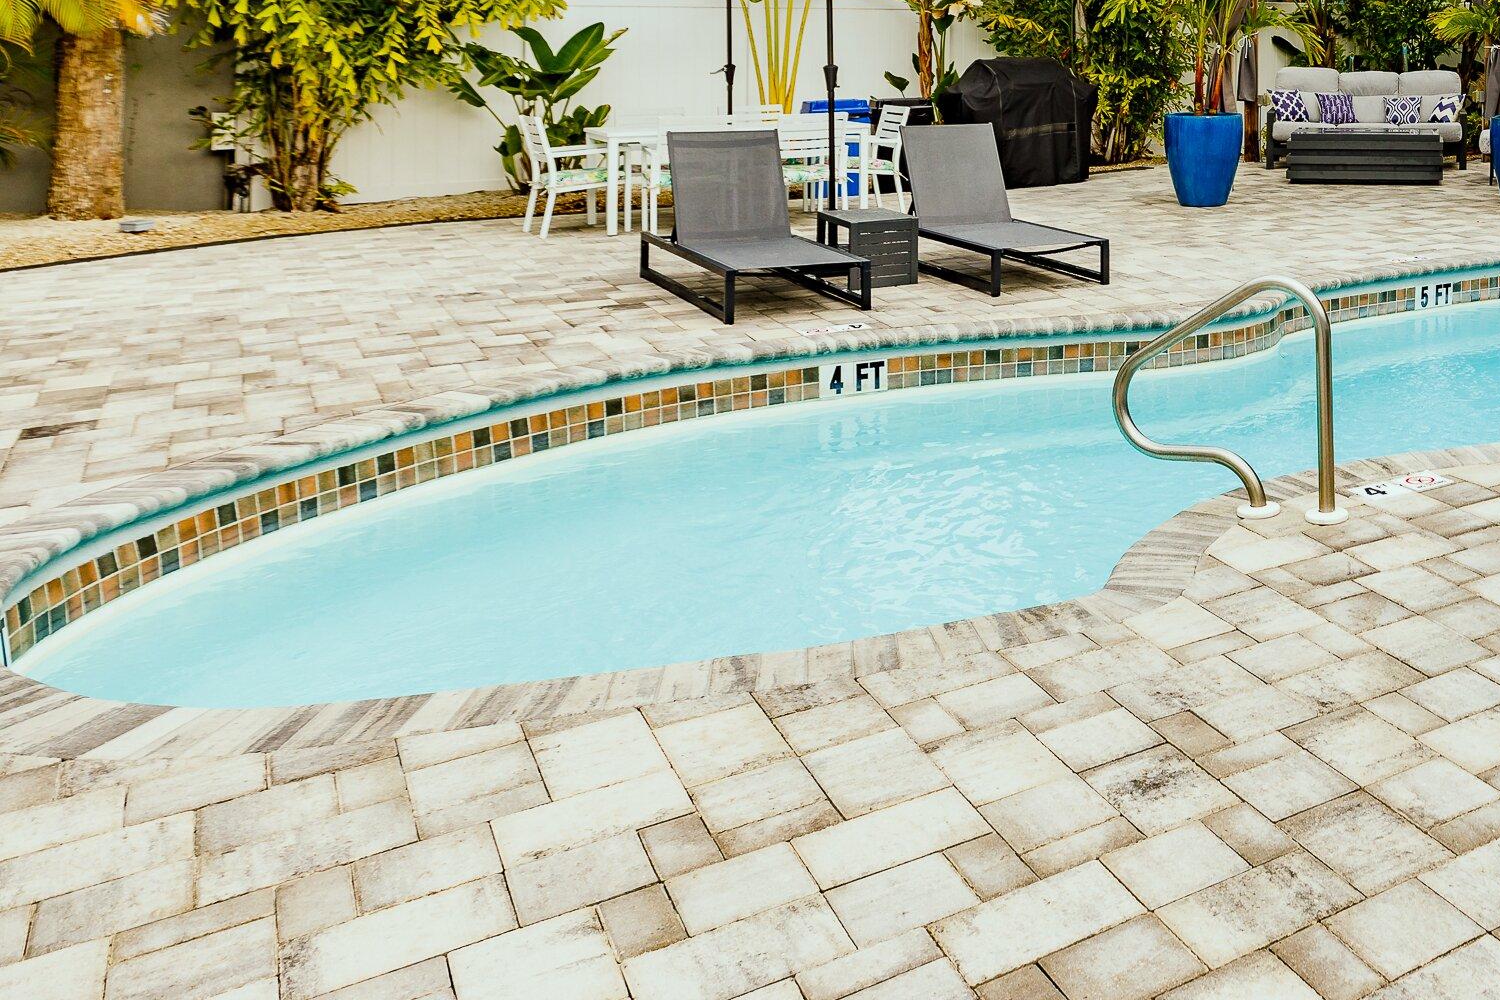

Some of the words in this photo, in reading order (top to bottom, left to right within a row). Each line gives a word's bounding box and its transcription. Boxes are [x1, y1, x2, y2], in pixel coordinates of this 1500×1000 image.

[1420, 286, 1429, 307] 5
[1434, 283, 1451, 305] FT
[829, 365, 844, 394] 4
[856, 360, 885, 392] FT
[1364, 487, 1388, 496] 4
